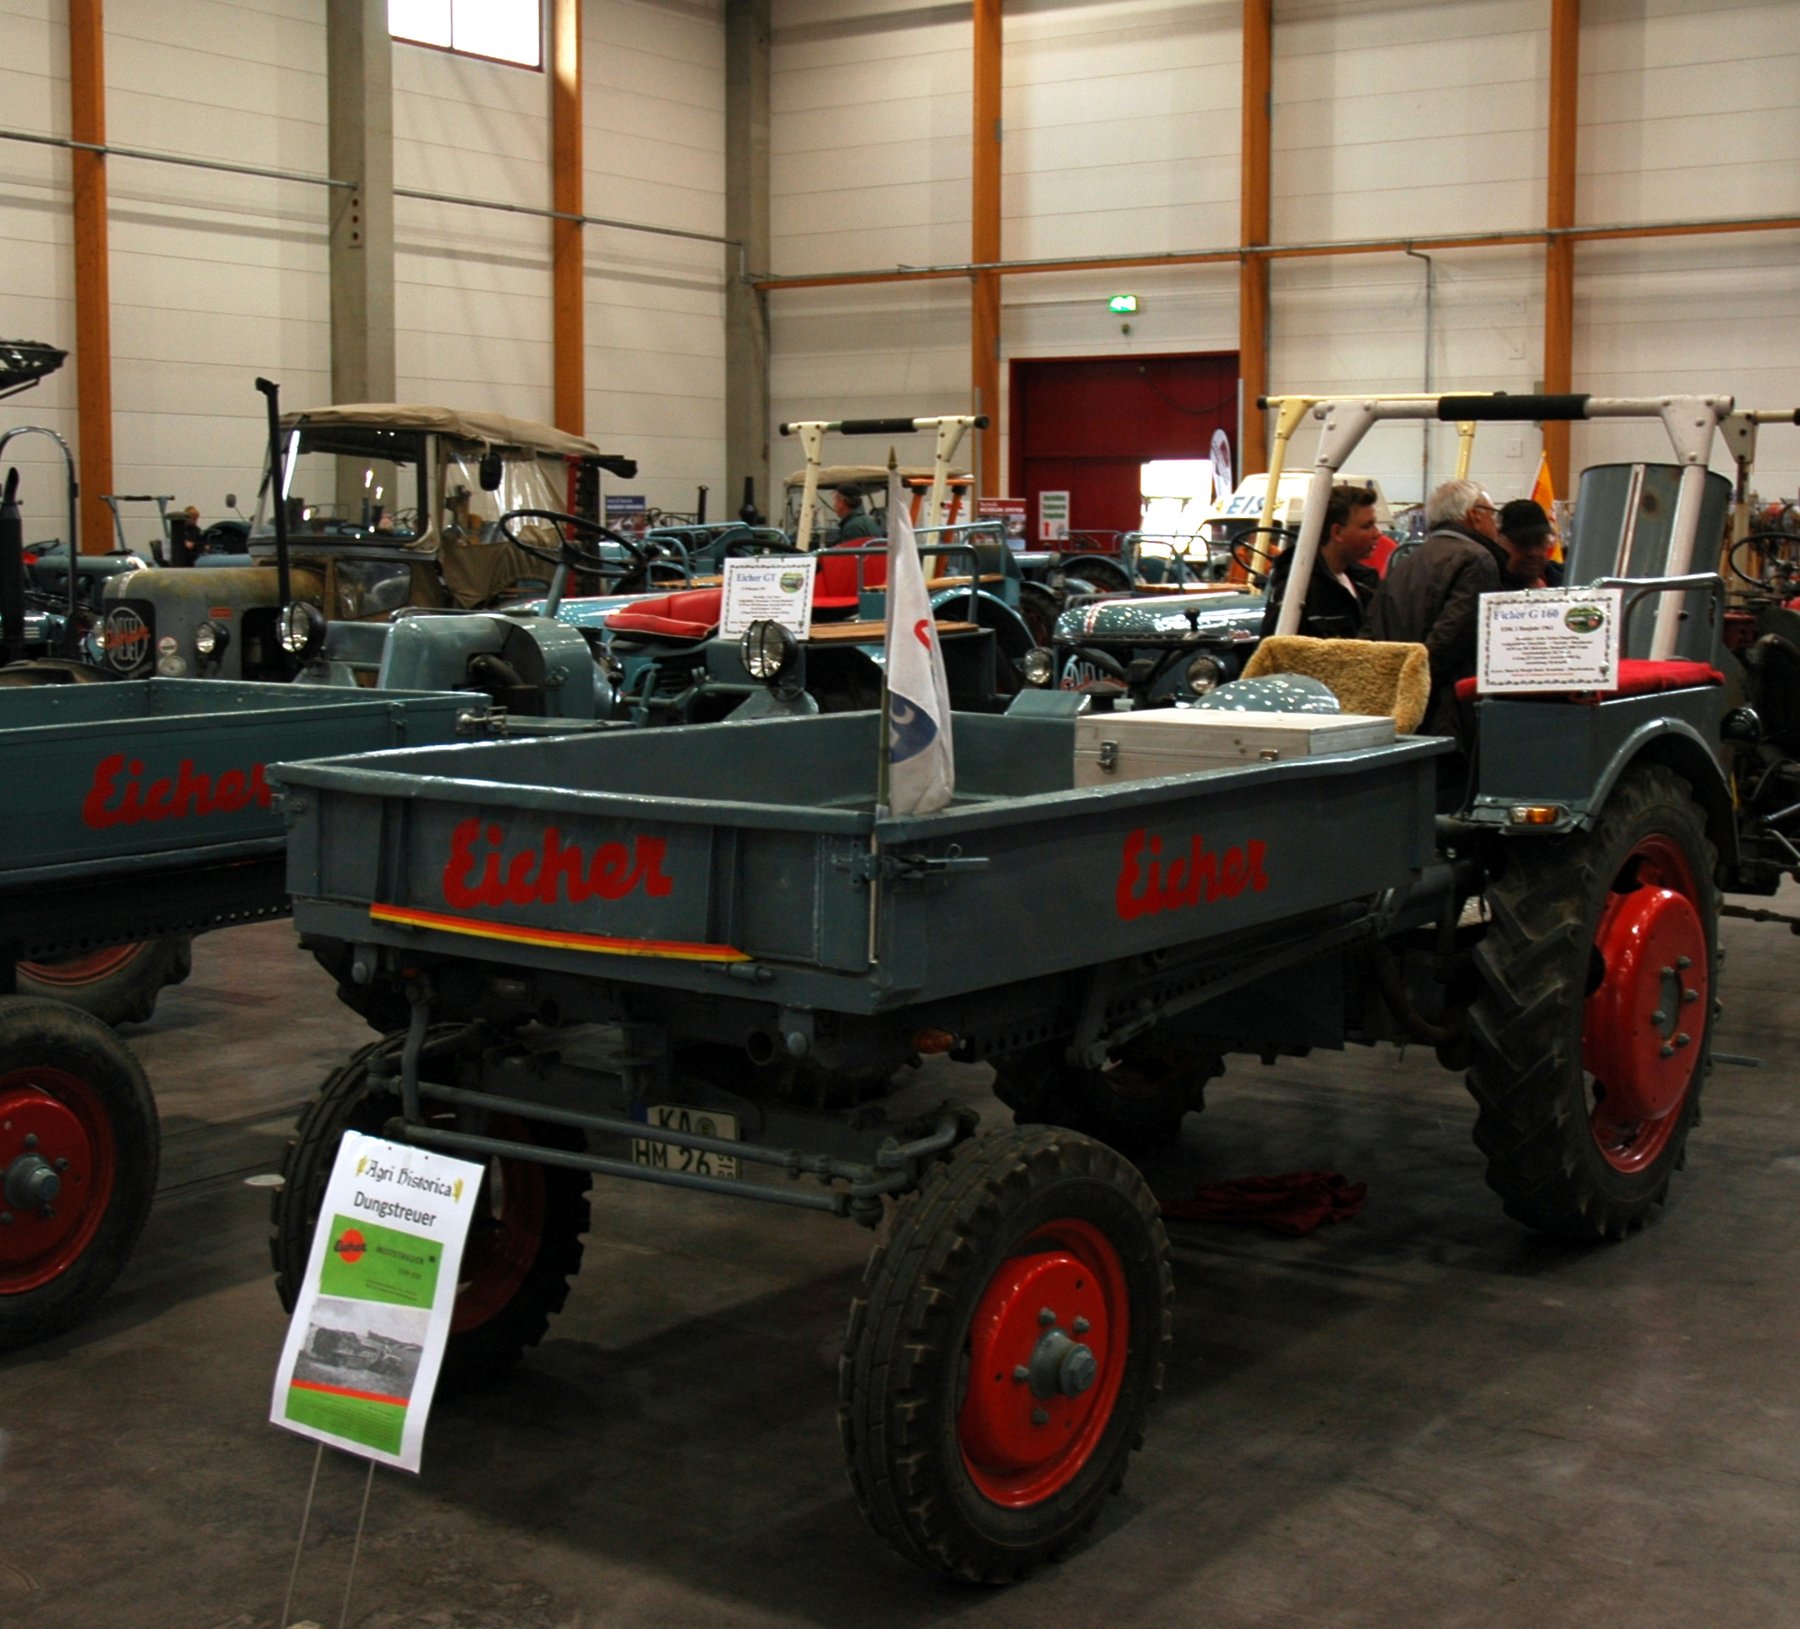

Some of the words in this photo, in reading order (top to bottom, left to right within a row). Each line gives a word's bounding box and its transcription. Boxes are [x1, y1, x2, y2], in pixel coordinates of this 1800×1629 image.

[1528, 609, 1538, 619] G
[82, 753, 273, 830] Eicher
[442, 816, 674, 910] Eicher
[1115, 827, 1270, 922] Eicher
[658, 1107, 691, 1133] KA
[634, 1139, 669, 1169] HM
[366, 1159, 395, 1183] Agri
[396, 1167, 452, 1197] Historica
[353, 1190, 437, 1228] Dungstreuer
